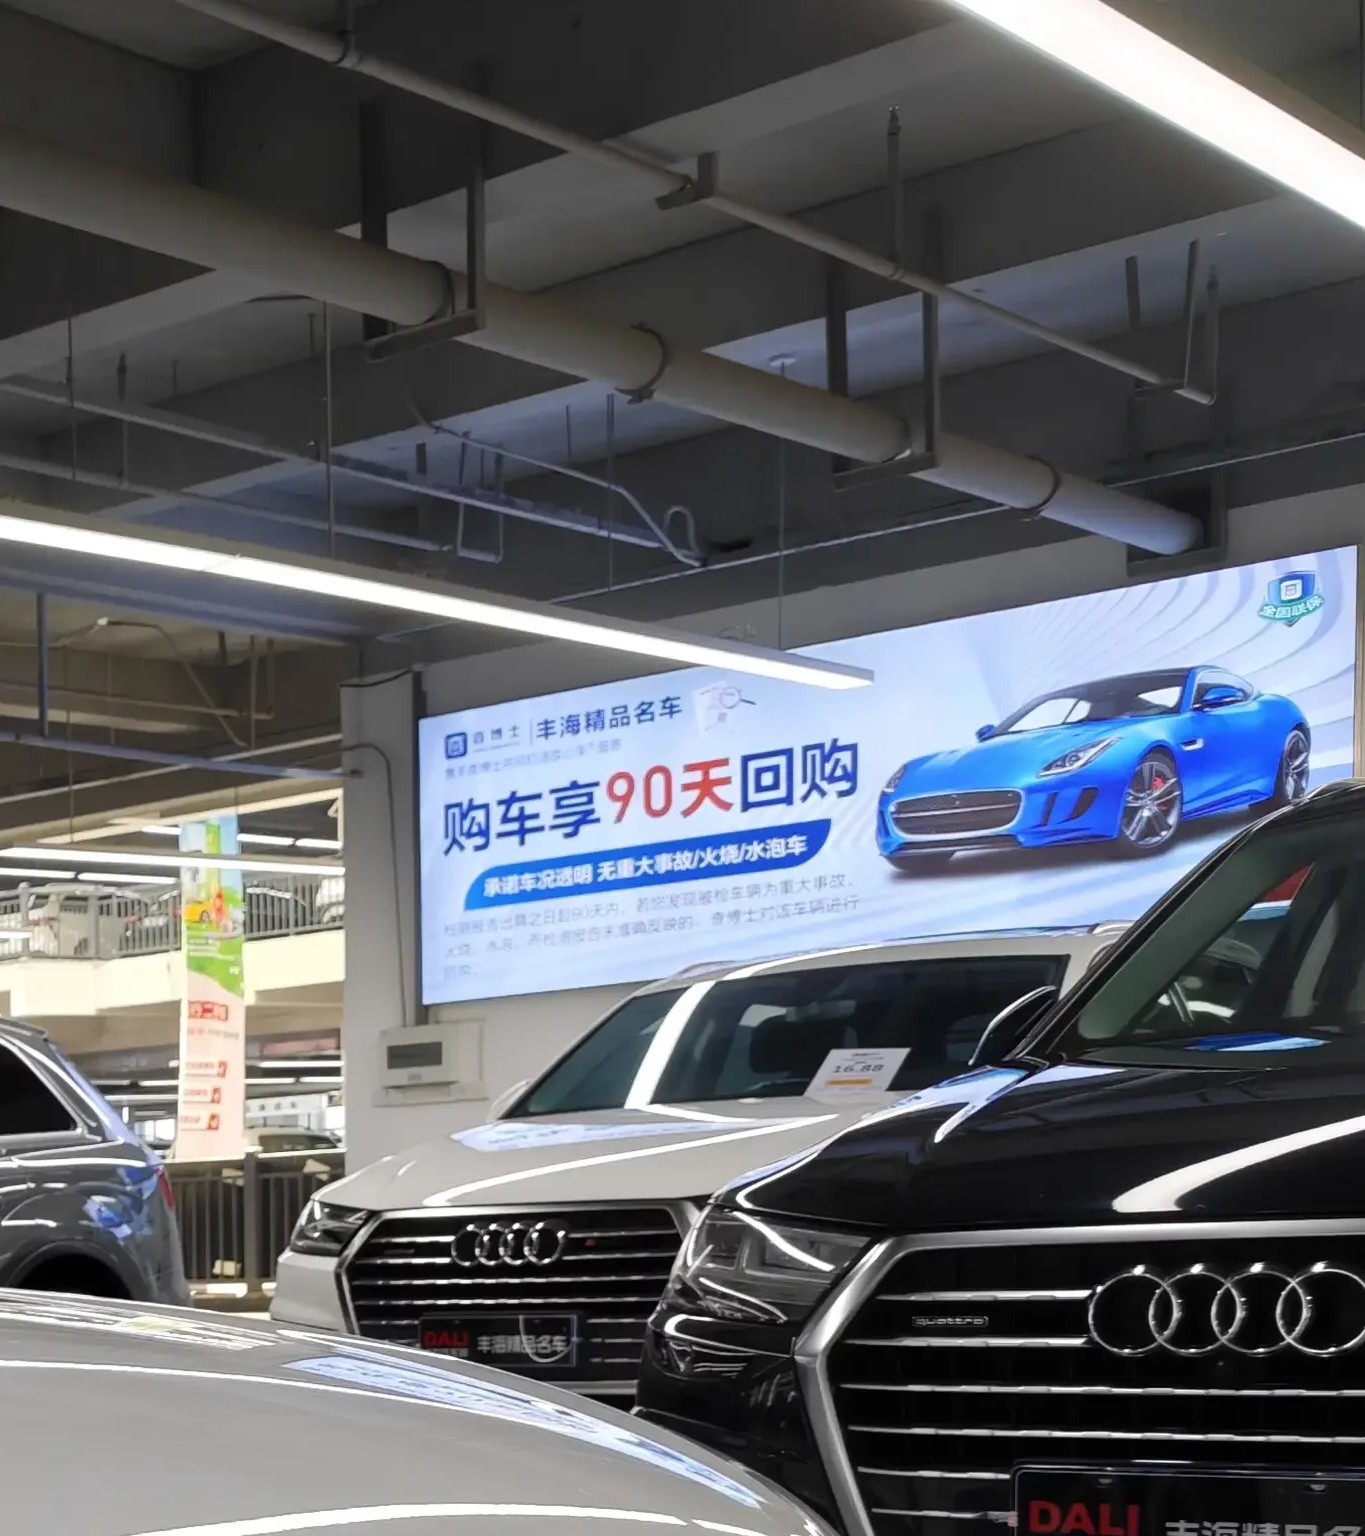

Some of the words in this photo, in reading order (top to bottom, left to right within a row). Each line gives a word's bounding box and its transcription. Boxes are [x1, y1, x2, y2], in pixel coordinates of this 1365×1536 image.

[536, 696, 683, 740] 丰海精品名车
[442, 738, 860, 857] 购车享90天回购
